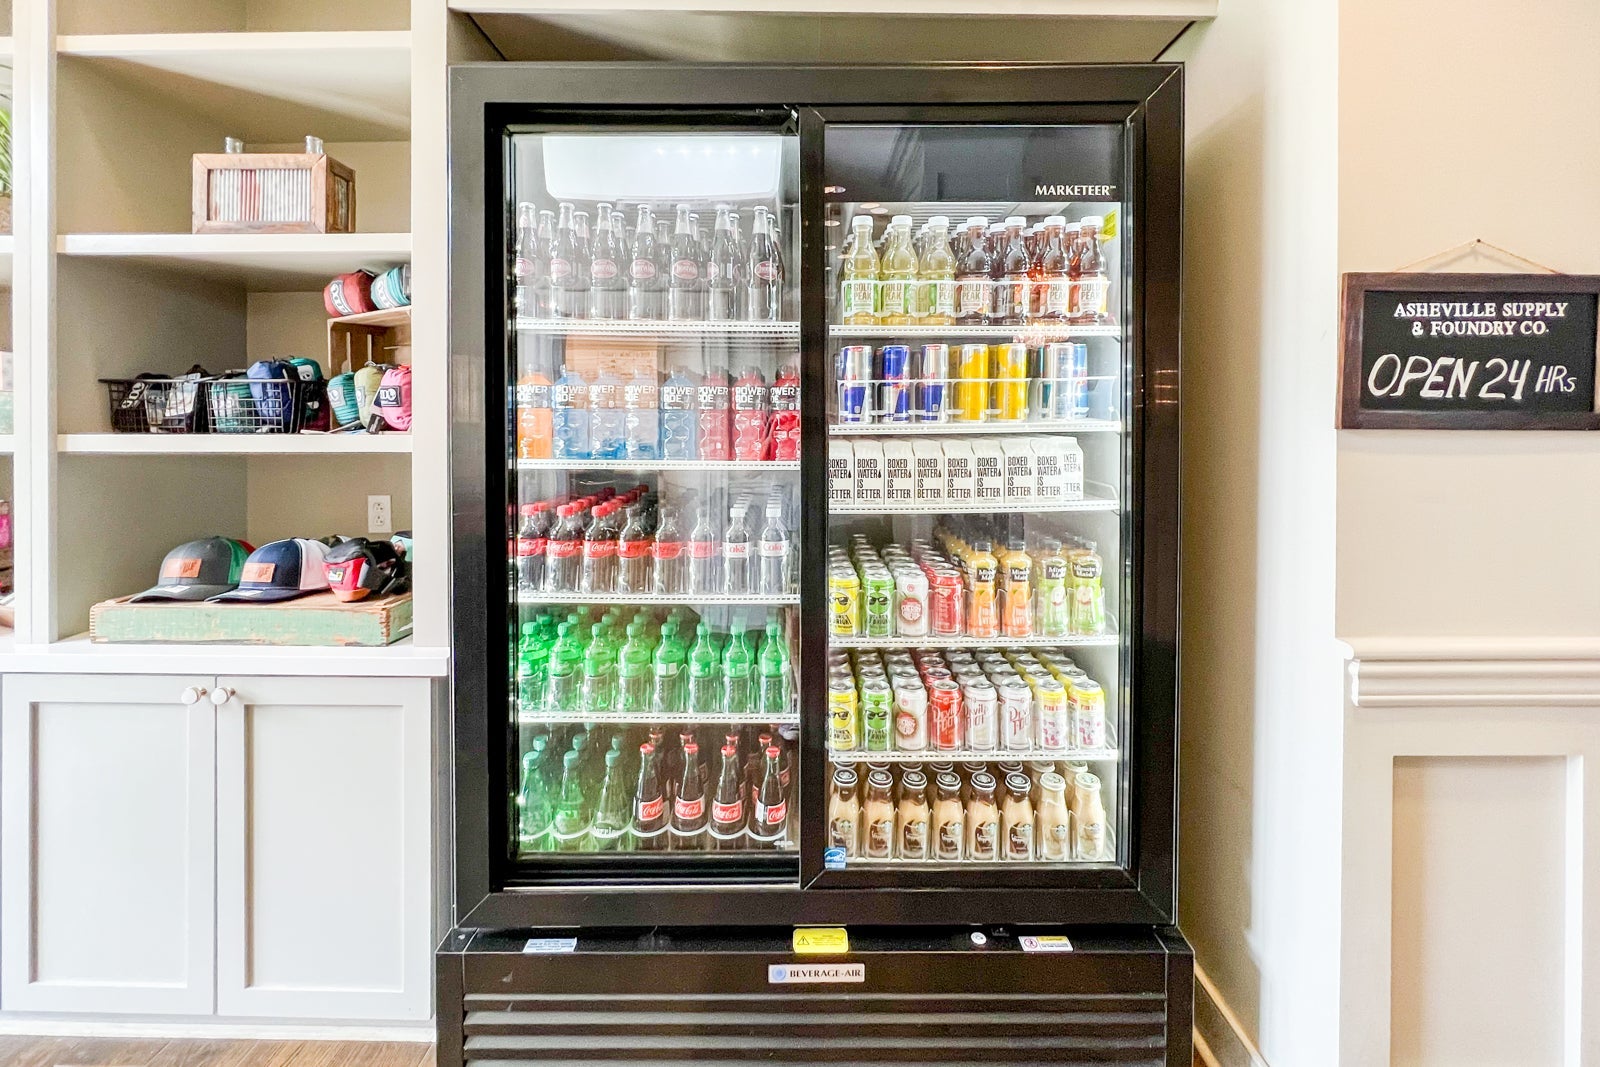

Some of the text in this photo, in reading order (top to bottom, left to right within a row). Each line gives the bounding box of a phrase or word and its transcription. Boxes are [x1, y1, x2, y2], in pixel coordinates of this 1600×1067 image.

[1393, 302, 1569, 317] ASHEVILLE SUPPLY
[1411, 321, 1550, 336] & FOUNDRY CO.
[1367, 353, 1480, 399] OPEN
[1478, 357, 1531, 400] 24
[663, 386, 695, 395] POWER
[697, 386, 728, 395] POWER
[735, 387, 766, 396] POWER
[857, 459, 877, 468] BOXED
[887, 459, 907, 468] BOXED
[917, 458, 937, 468] BOXED
[947, 458, 967, 468] BOXED
[977, 457, 997, 467] BOXED
[1007, 456, 1028, 466] BOXED
[1037, 456, 1057, 466] BOXED
[857, 469, 877, 478] WATER
[887, 469, 908, 478] WATER
[917, 469, 938, 478] WATER
[947, 469, 968, 478] WATER
[977, 468, 997, 477] WATER
[1007, 466, 1028, 476] WATER
[1037, 466, 1058, 476] WATER
[857, 479, 863, 488] IS
[887, 479, 893, 488] IS
[917, 479, 923, 488] IS
[947, 479, 954, 488] IS
[977, 478, 983, 487] IS
[1007, 476, 1014, 486] IS
[1037, 476, 1044, 486] IS
[790, 969, 861, 978] BEVERAGE-AIR
